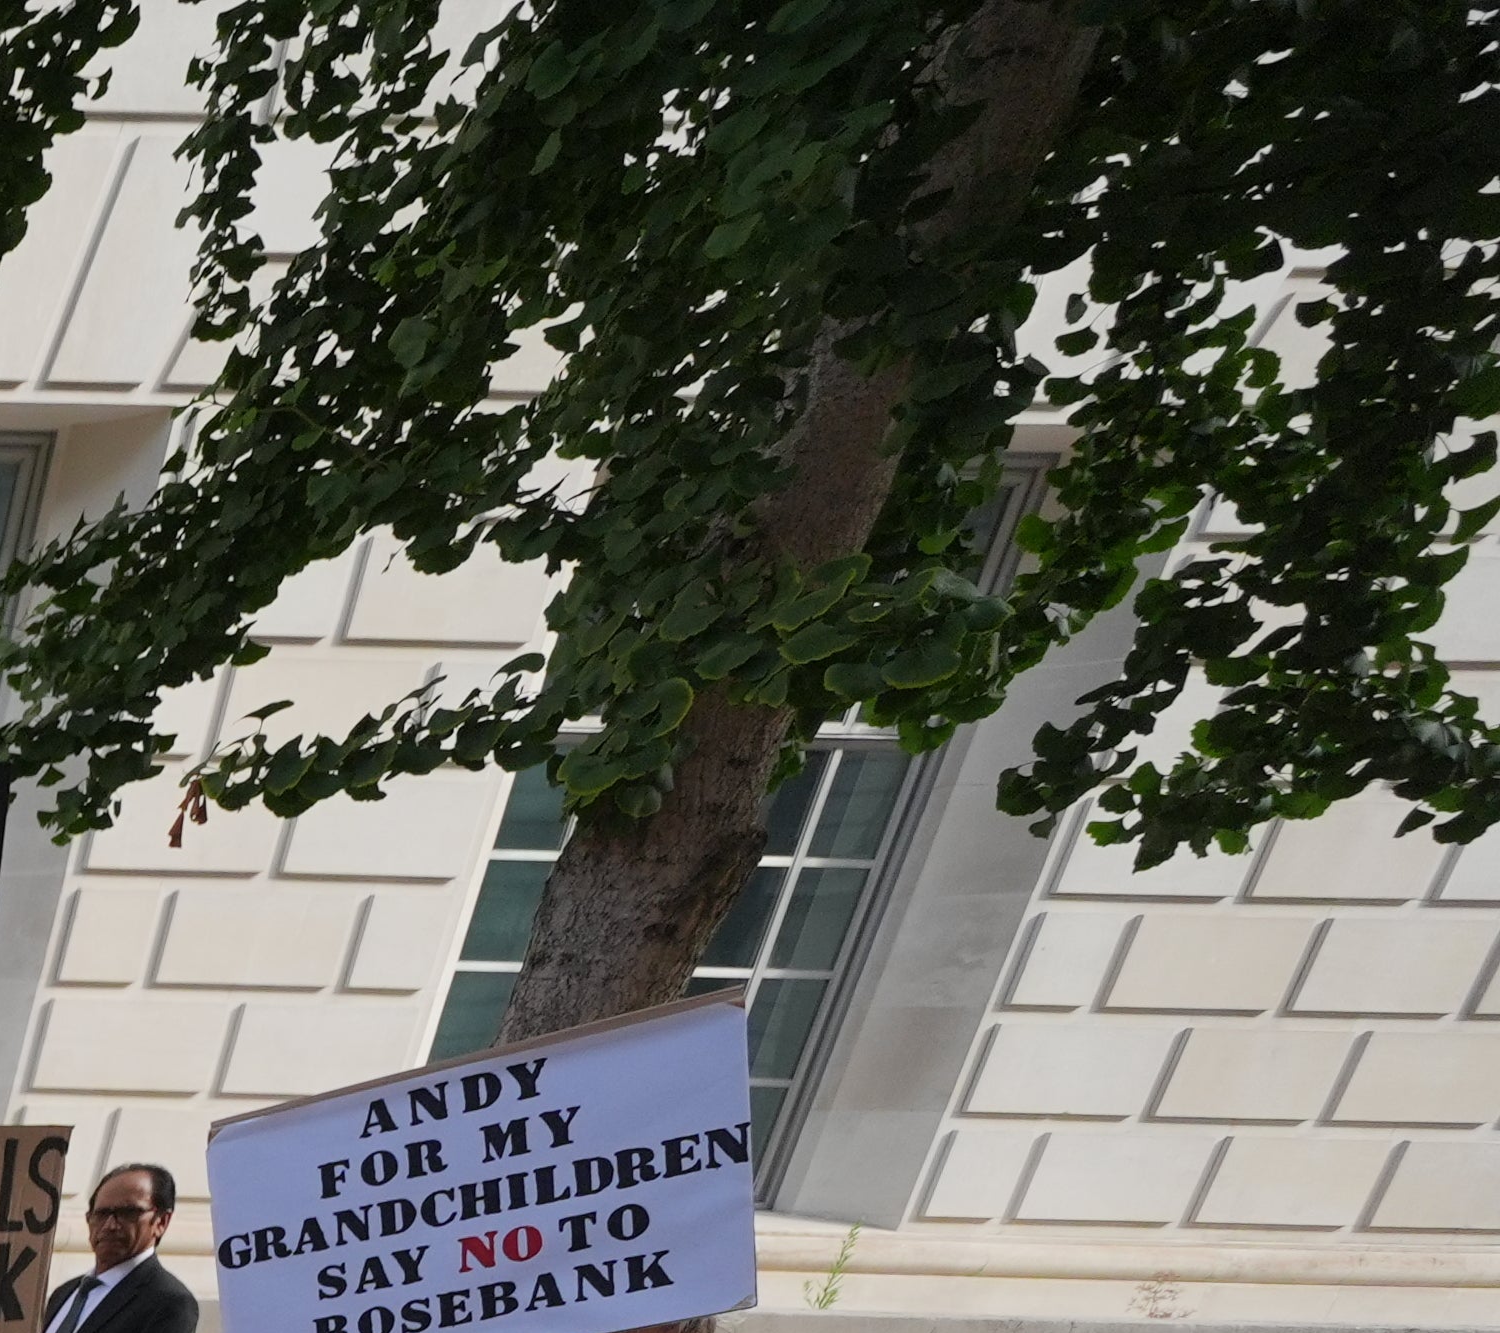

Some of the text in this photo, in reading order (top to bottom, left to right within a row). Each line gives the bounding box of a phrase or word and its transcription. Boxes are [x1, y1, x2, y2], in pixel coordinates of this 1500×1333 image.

[359, 1057, 548, 1139] ANDY
[218, 1122, 752, 1270] GRANDCHILDREN
[317, 1106, 581, 1199] FOR MY
[316, 1203, 651, 1300] SAY NO TO
